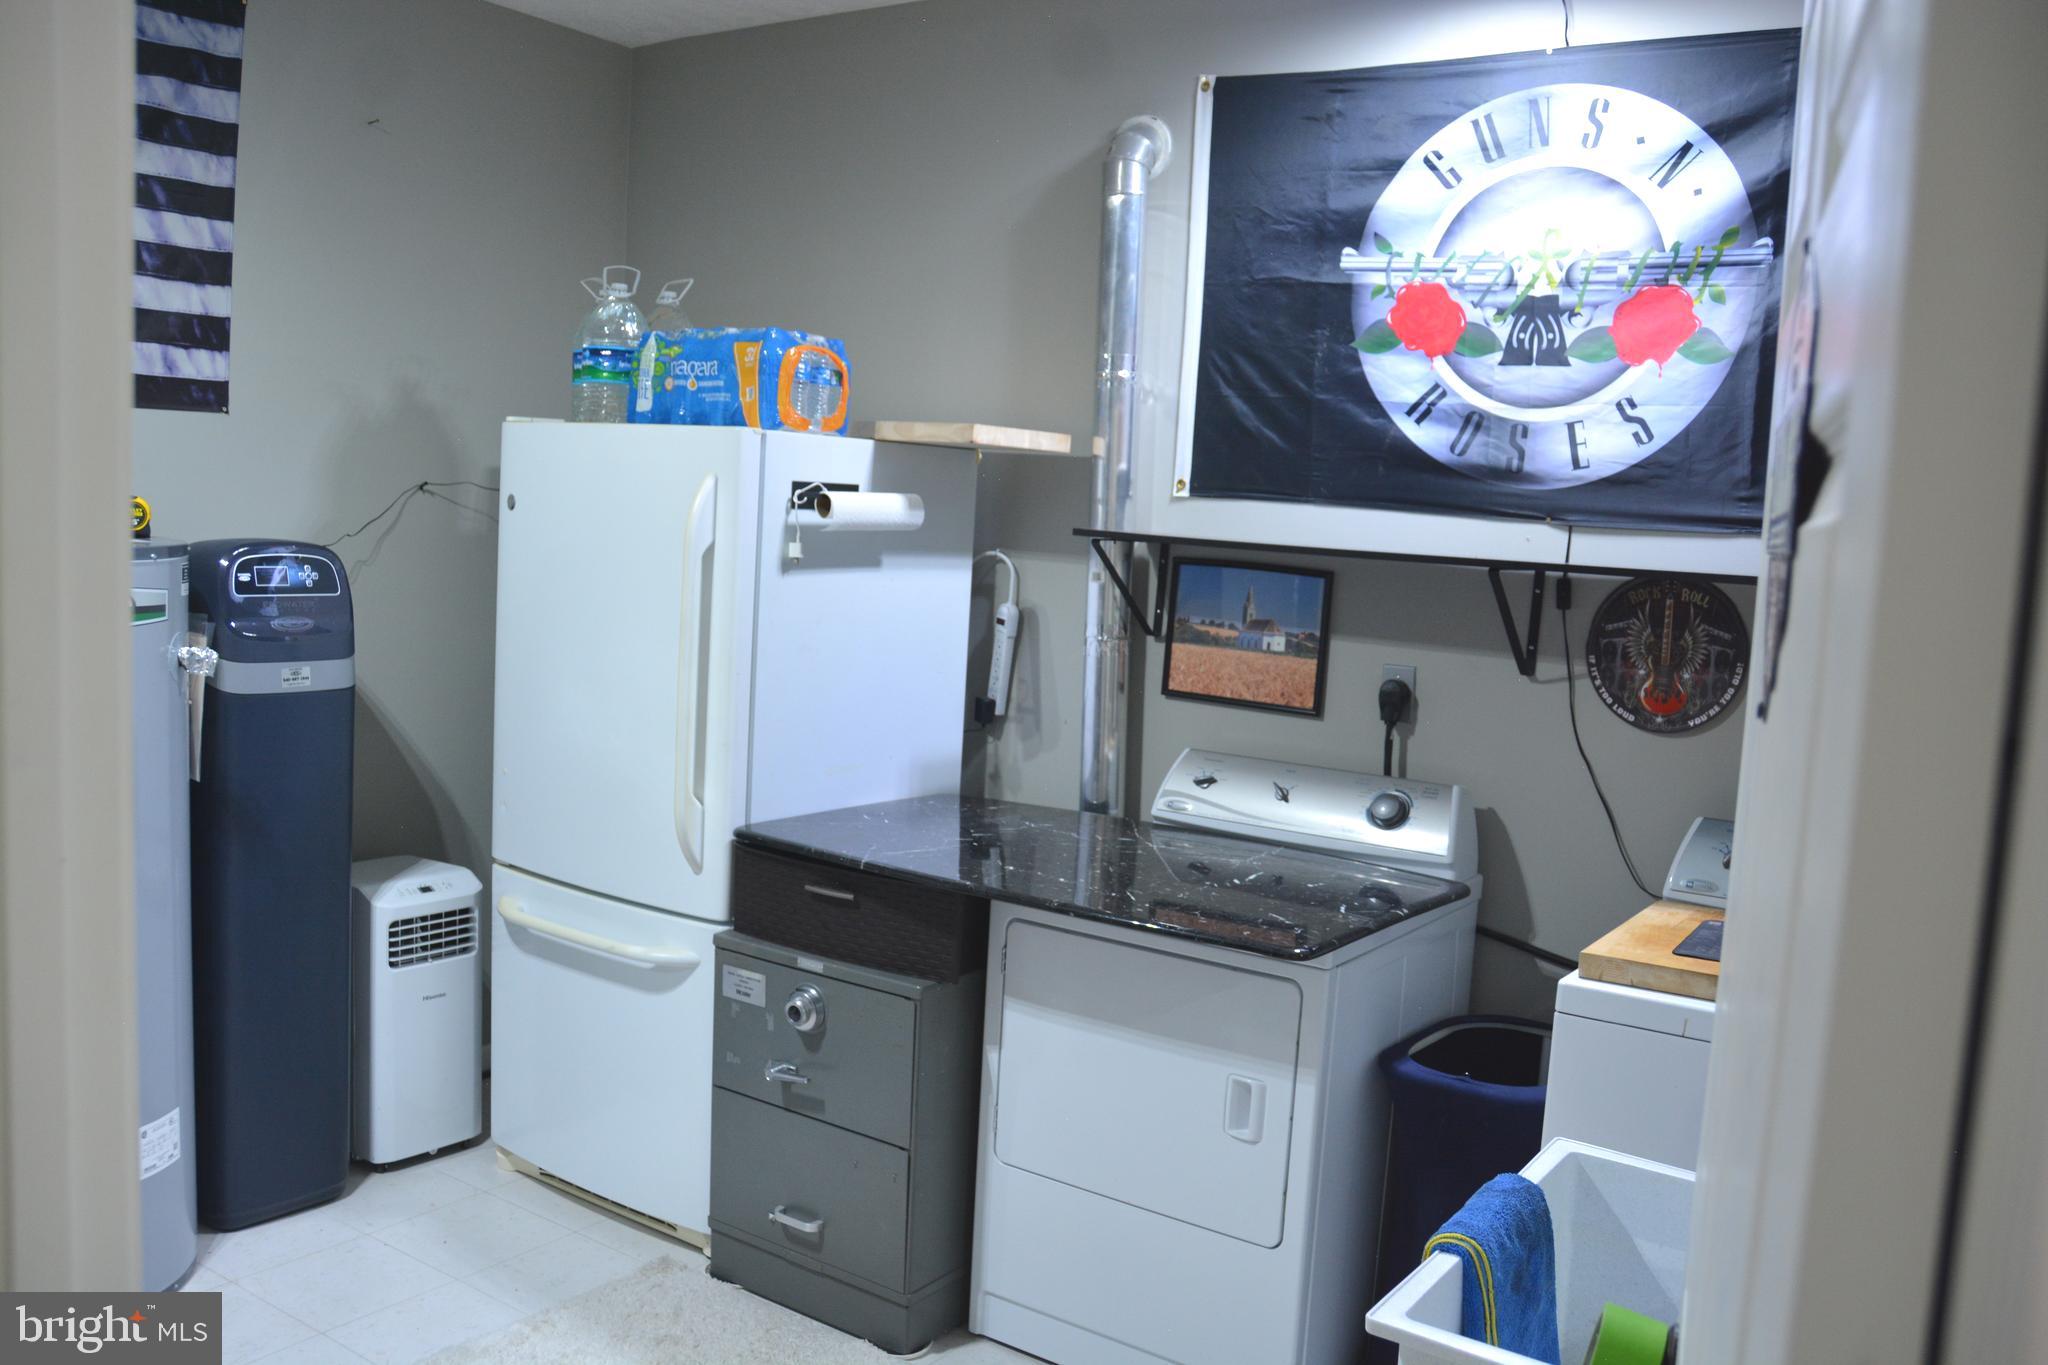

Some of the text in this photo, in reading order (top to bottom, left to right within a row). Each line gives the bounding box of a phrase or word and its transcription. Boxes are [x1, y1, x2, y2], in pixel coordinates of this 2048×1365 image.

[1422, 95, 1611, 190] GUNS
[670, 359, 719, 380] niagara
[1404, 383, 1655, 474] ROSES
[1681, 587, 1710, 608] ROLL
[1599, 686, 1613, 705] TOO
[1612, 703, 1636, 722] LOUD
[1687, 704, 1721, 727] YOU'RE
[1719, 687, 1735, 705] TOO
